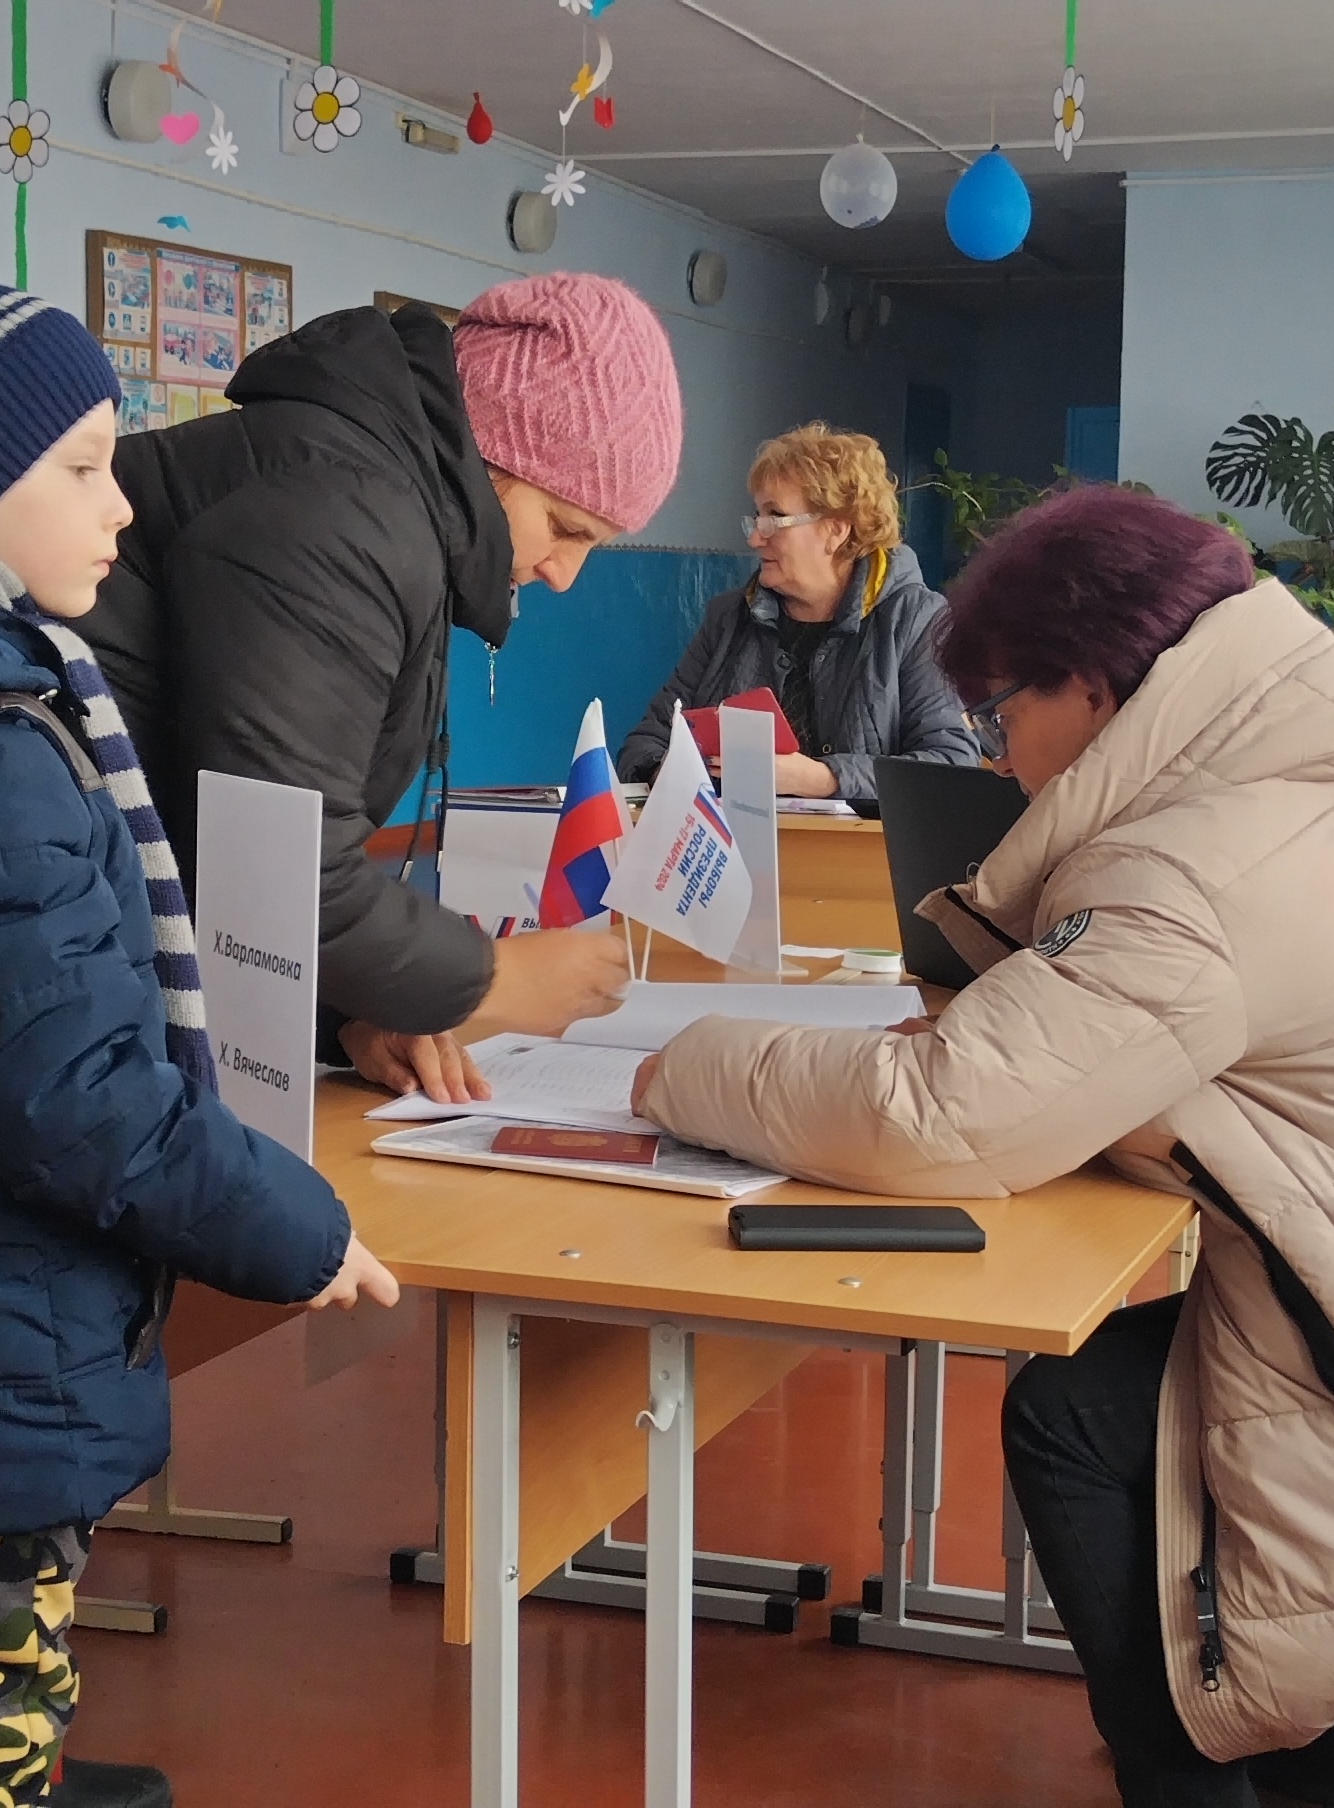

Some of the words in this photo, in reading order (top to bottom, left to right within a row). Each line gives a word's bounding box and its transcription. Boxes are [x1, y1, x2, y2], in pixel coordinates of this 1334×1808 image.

[676, 837, 718, 916] ПРЕЗИДЕНТА
[677, 823, 707, 878] РОССИИ
[698, 850, 728, 909] ВЫБОРЫ
[213, 929, 302, 981] Х.Варламовка
[218, 1041, 230, 1067] Х.
[233, 1048, 290, 1092] Вячеслав
